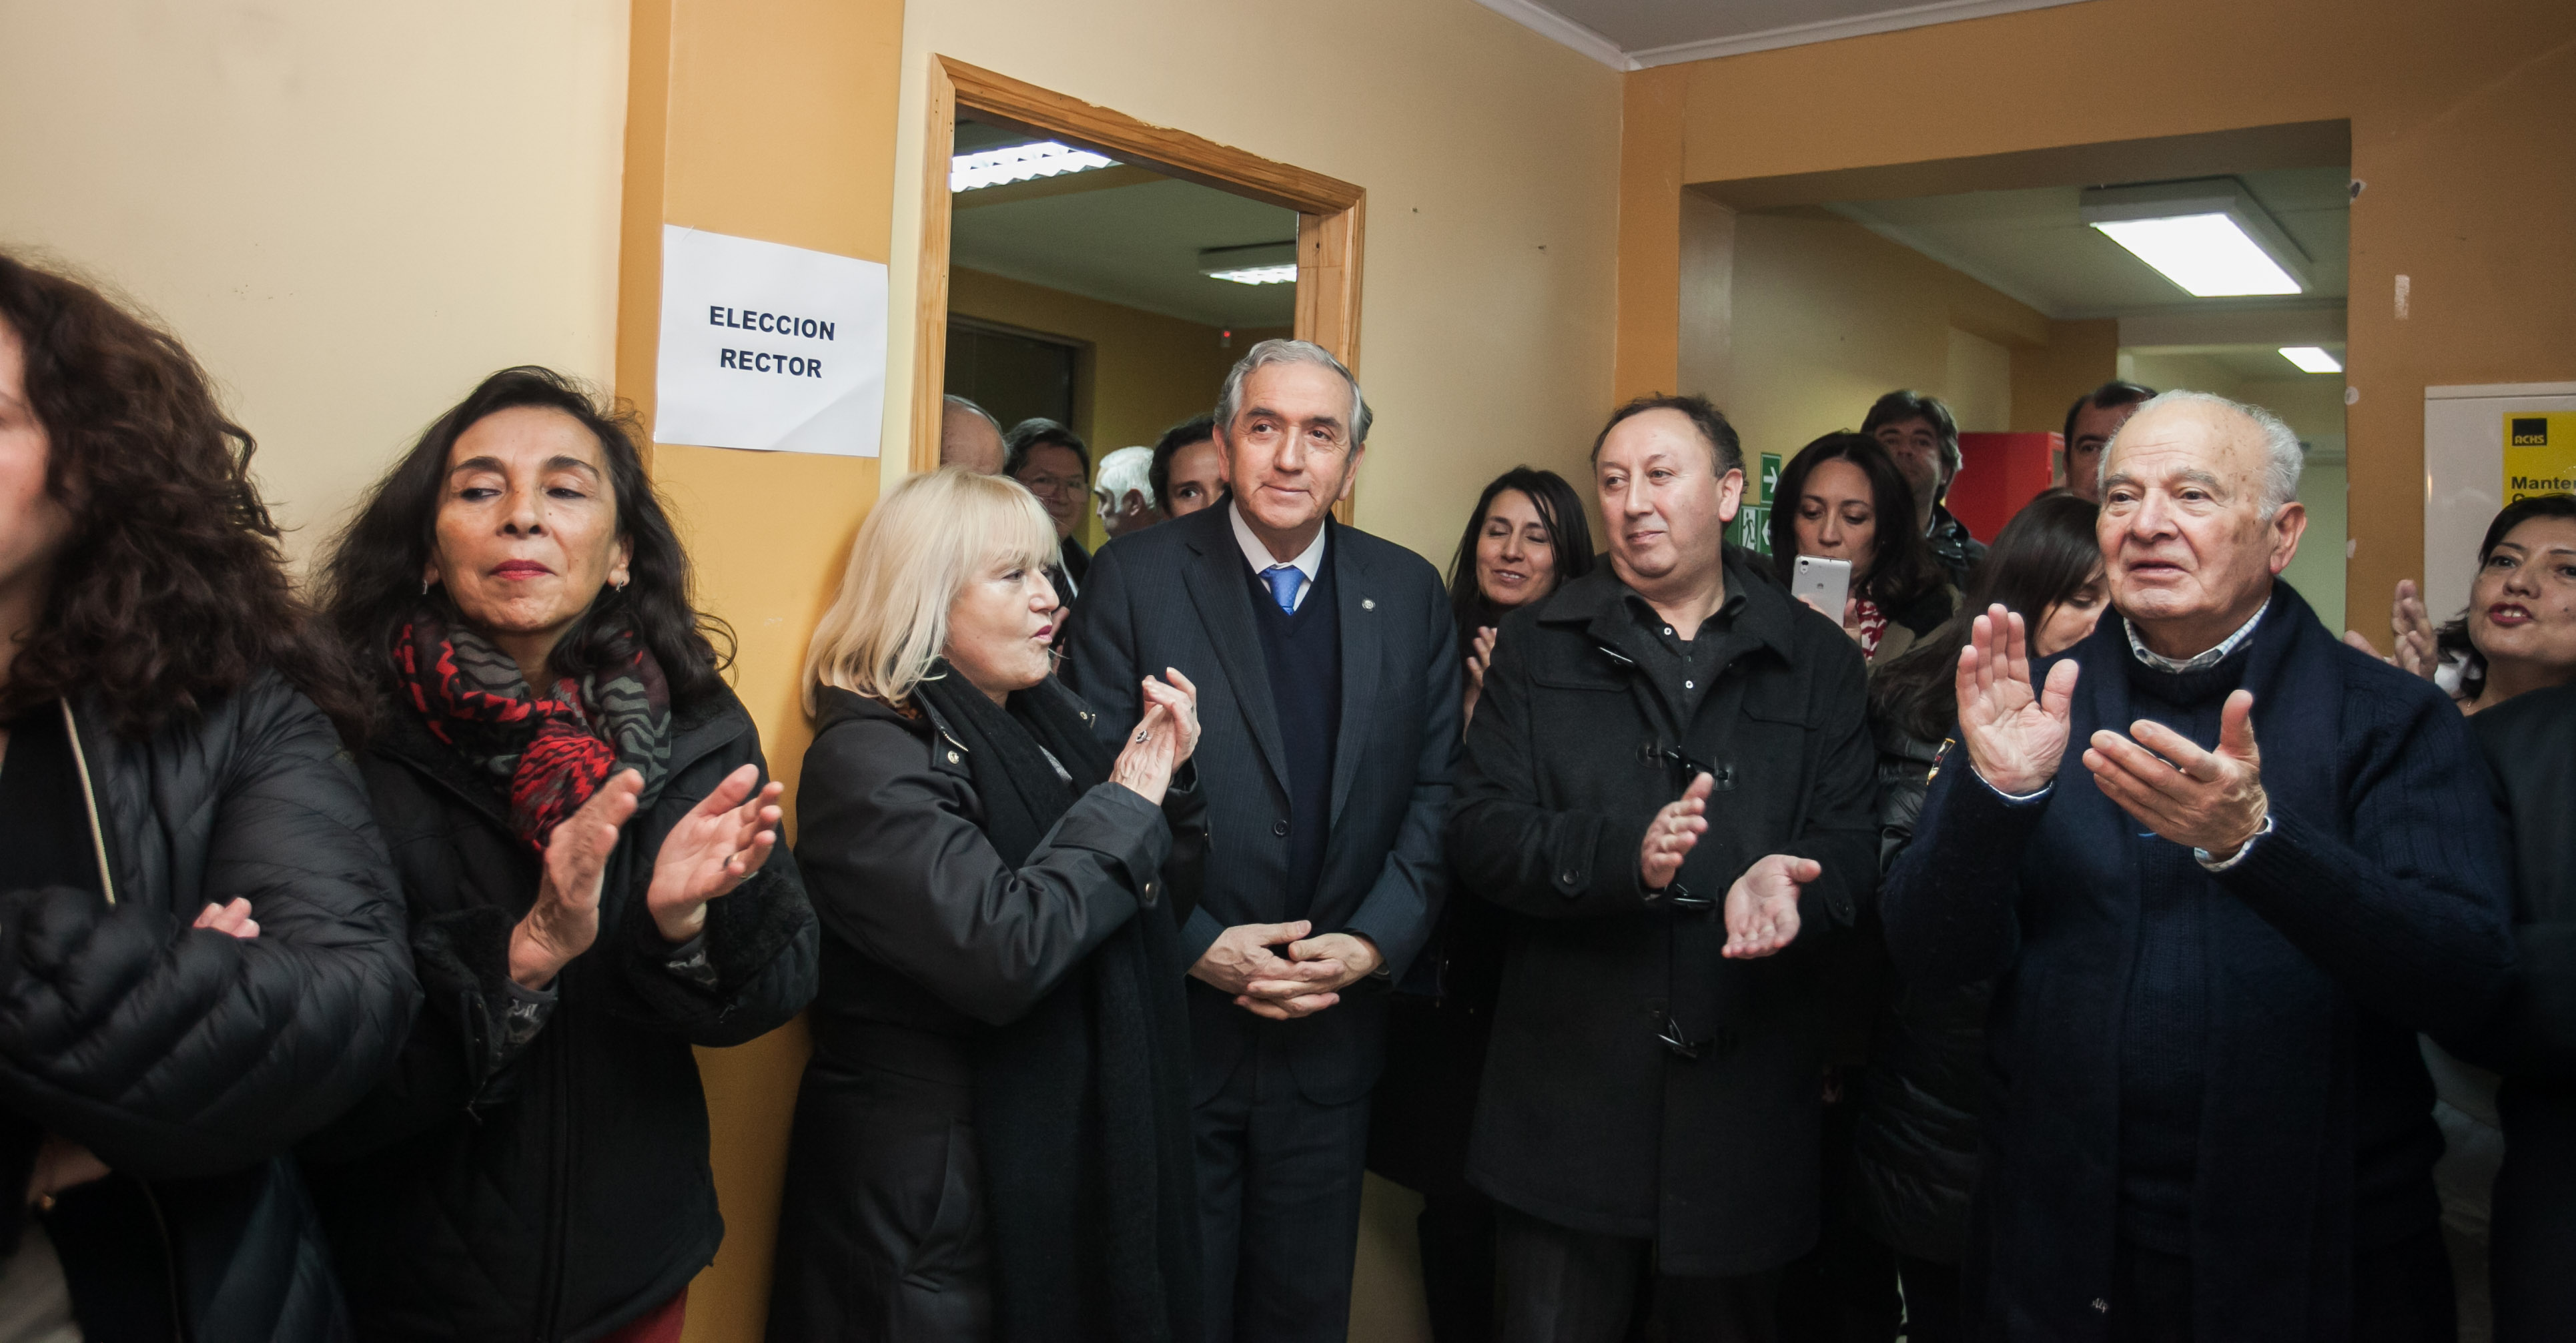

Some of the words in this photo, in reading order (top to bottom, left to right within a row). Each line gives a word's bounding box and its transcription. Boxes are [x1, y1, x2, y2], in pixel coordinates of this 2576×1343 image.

[710, 306, 835, 341] ELECCION
[721, 348, 822, 378] RECTOR
[2515, 435, 2544, 444] ACHS
[2511, 476, 2576, 490] Mante
